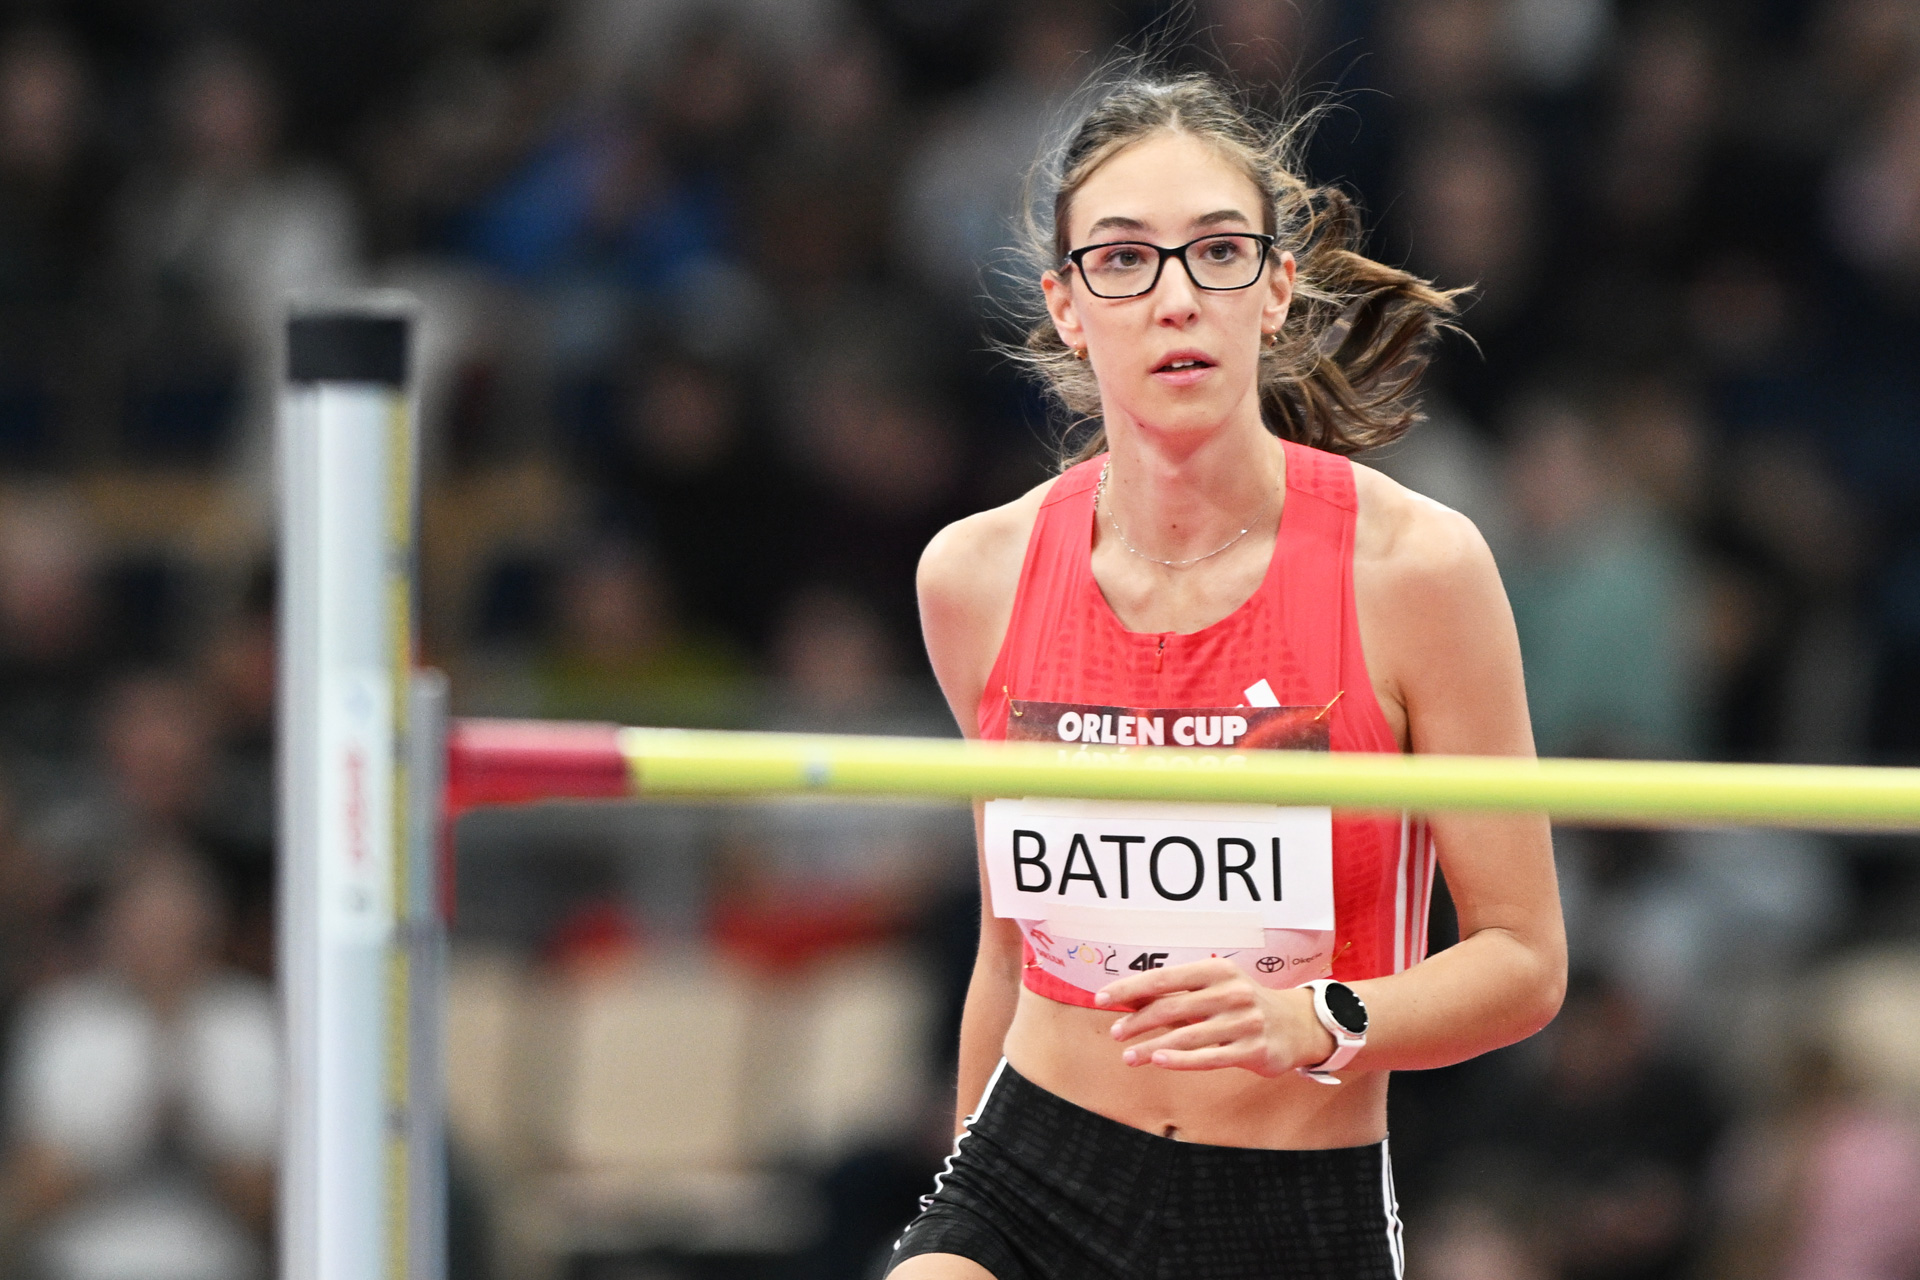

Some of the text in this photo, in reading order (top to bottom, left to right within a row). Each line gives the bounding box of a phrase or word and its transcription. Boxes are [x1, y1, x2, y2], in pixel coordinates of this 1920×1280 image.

[1057, 711, 1248, 746] ORLEN CUP
[1012, 829, 1282, 902] BATORI
